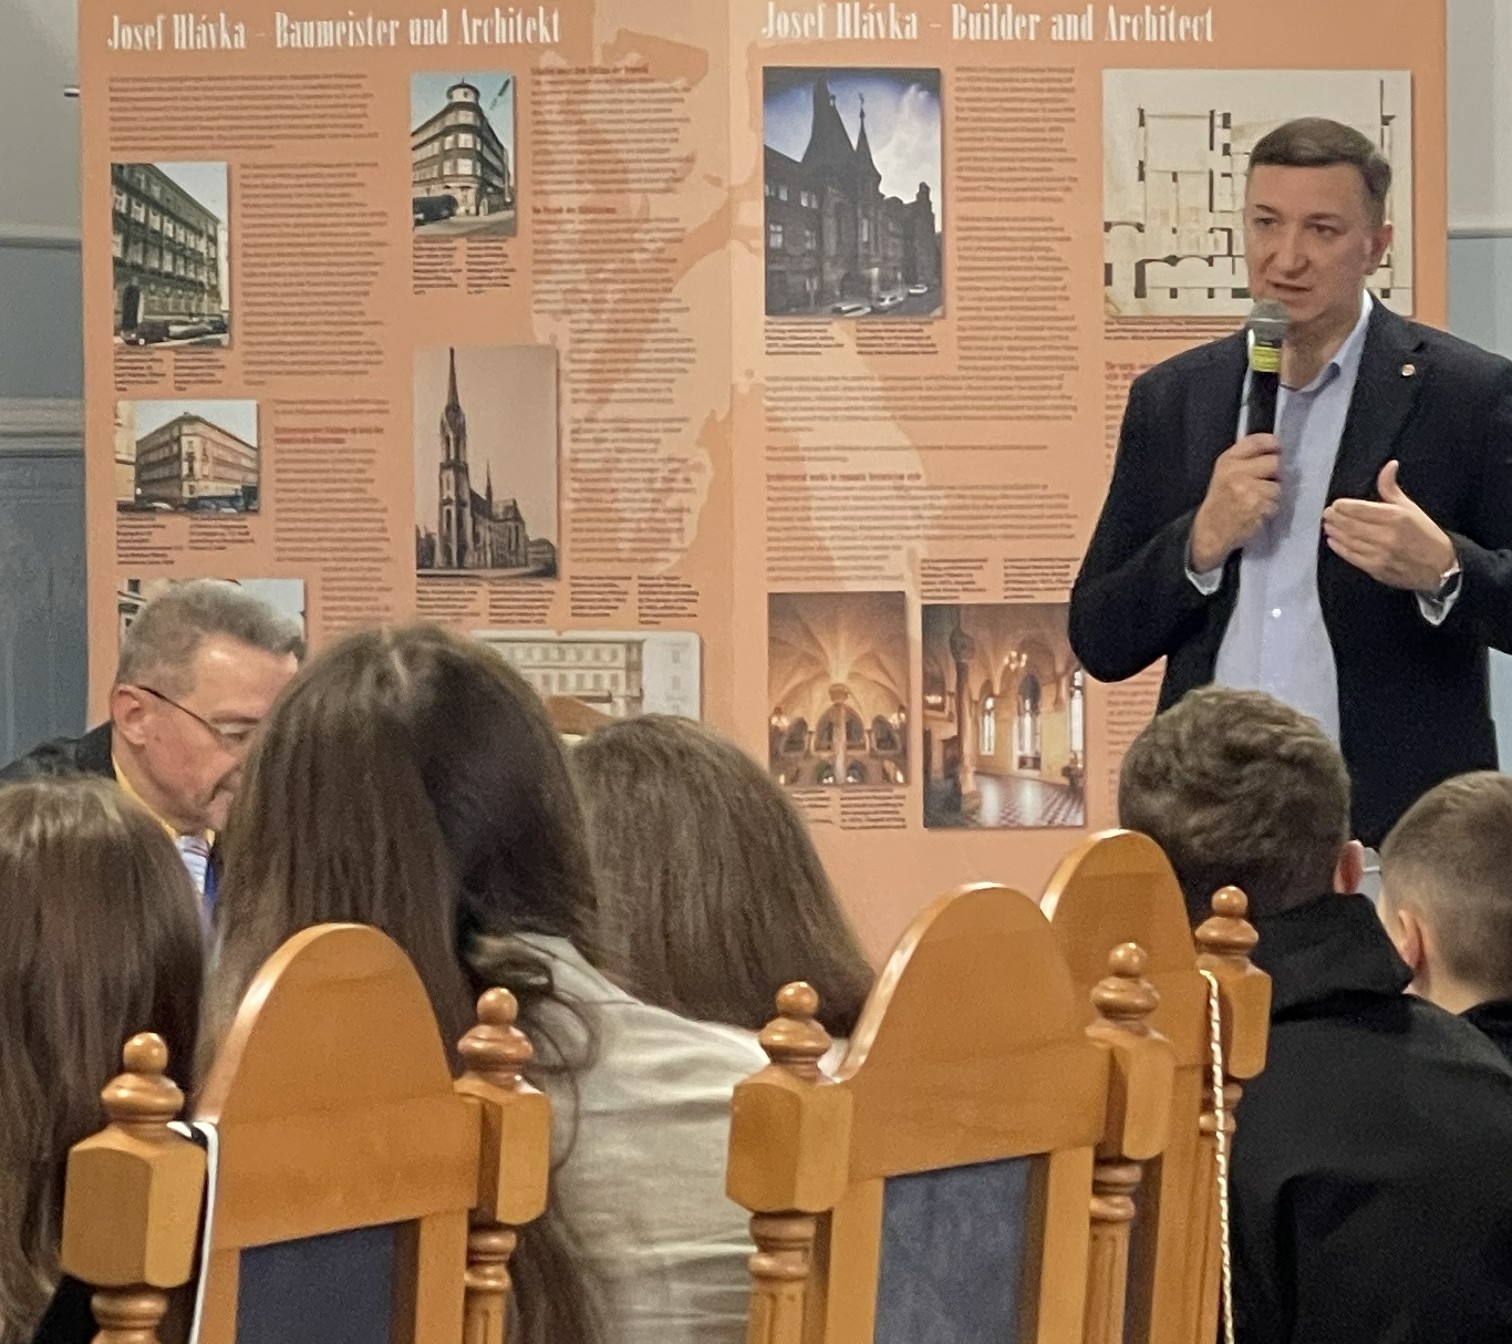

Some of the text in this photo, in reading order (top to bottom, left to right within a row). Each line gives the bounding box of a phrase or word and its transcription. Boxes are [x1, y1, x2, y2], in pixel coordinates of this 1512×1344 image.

[107, 13, 166, 51] Josef
[275, 10, 400, 48] Baumeister
[409, 8, 449, 45] und
[458, 6, 560, 46] Architekt
[762, 2, 825, 39] Josef
[836, 1, 919, 40] Hlávka
[952, 3, 1041, 41] Builder
[1051, 3, 1094, 42] and
[1105, 5, 1215, 42] Architect
